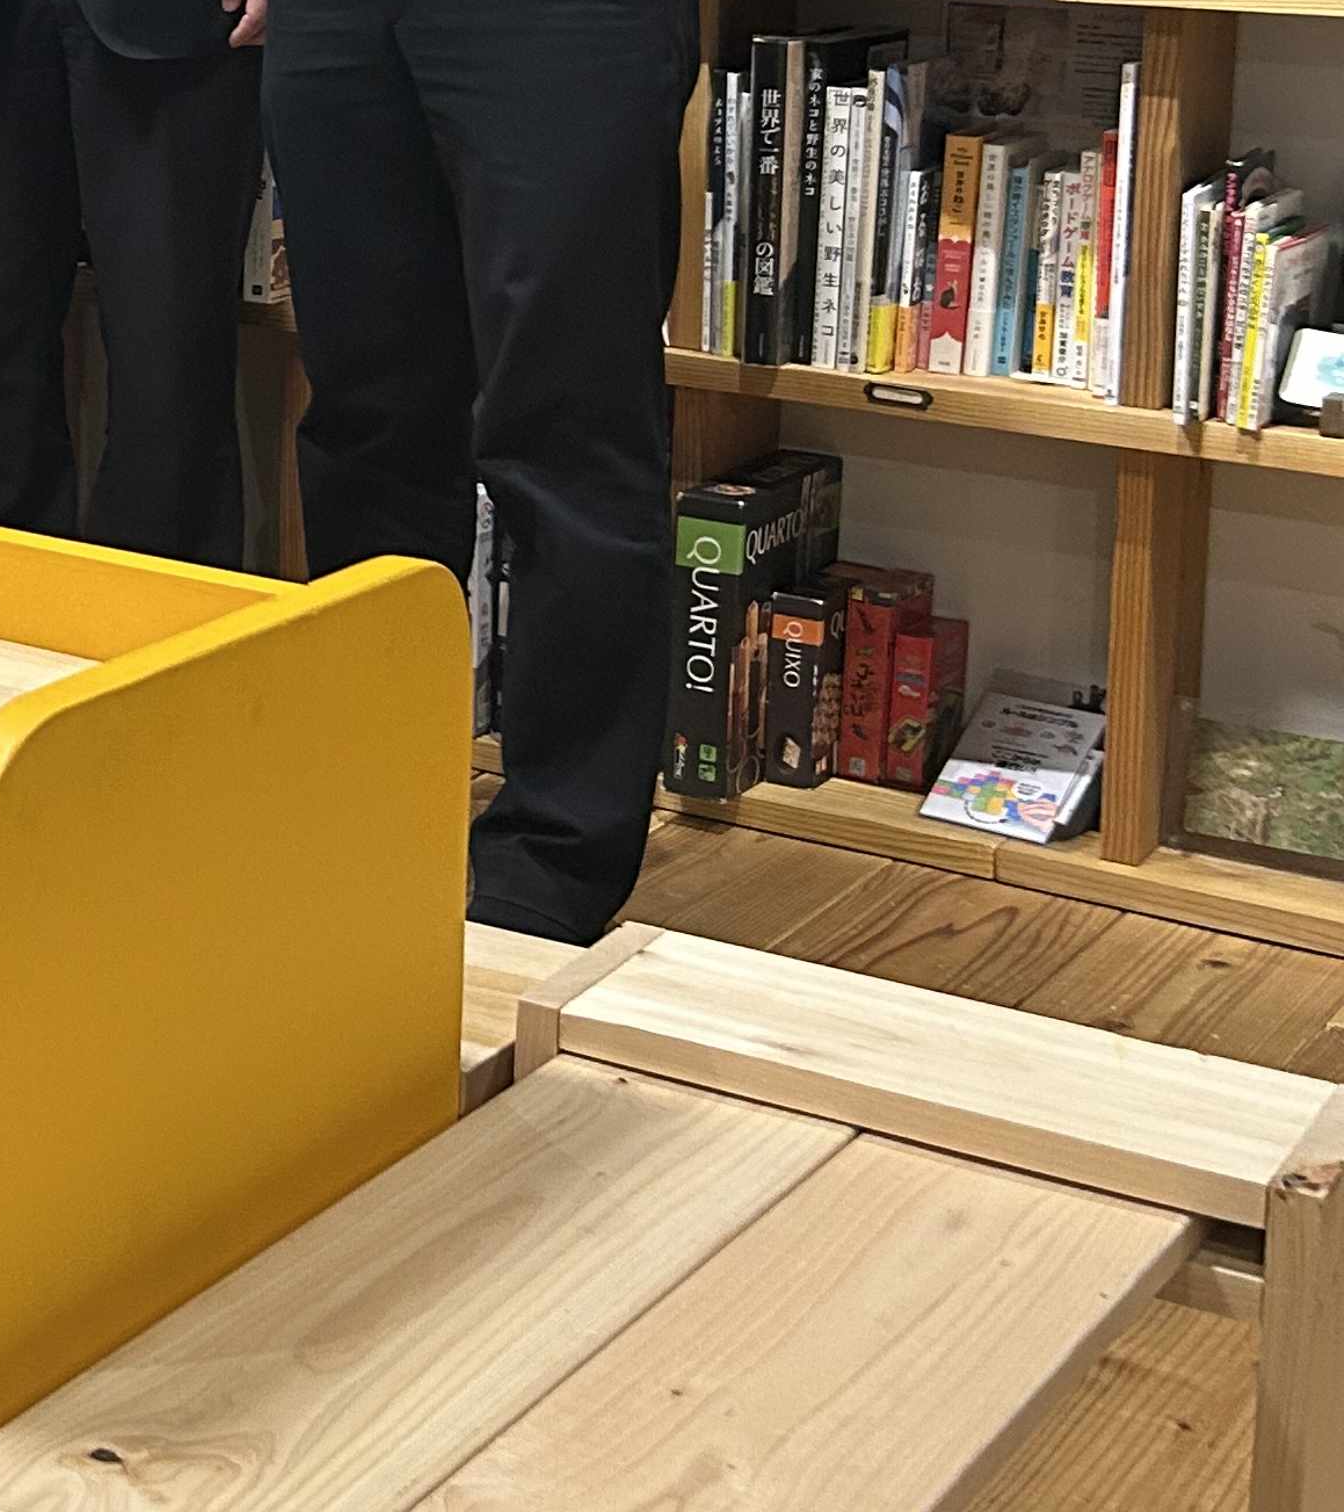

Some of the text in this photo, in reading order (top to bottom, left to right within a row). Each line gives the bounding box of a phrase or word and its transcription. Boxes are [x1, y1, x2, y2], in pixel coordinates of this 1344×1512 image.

[821, 92, 851, 335] 世界の美しい野生ネコ
[1056, 181, 1076, 288] ボードゲーム教育
[686, 536, 722, 694] QUARTO!
[783, 620, 804, 688] QUIXO
